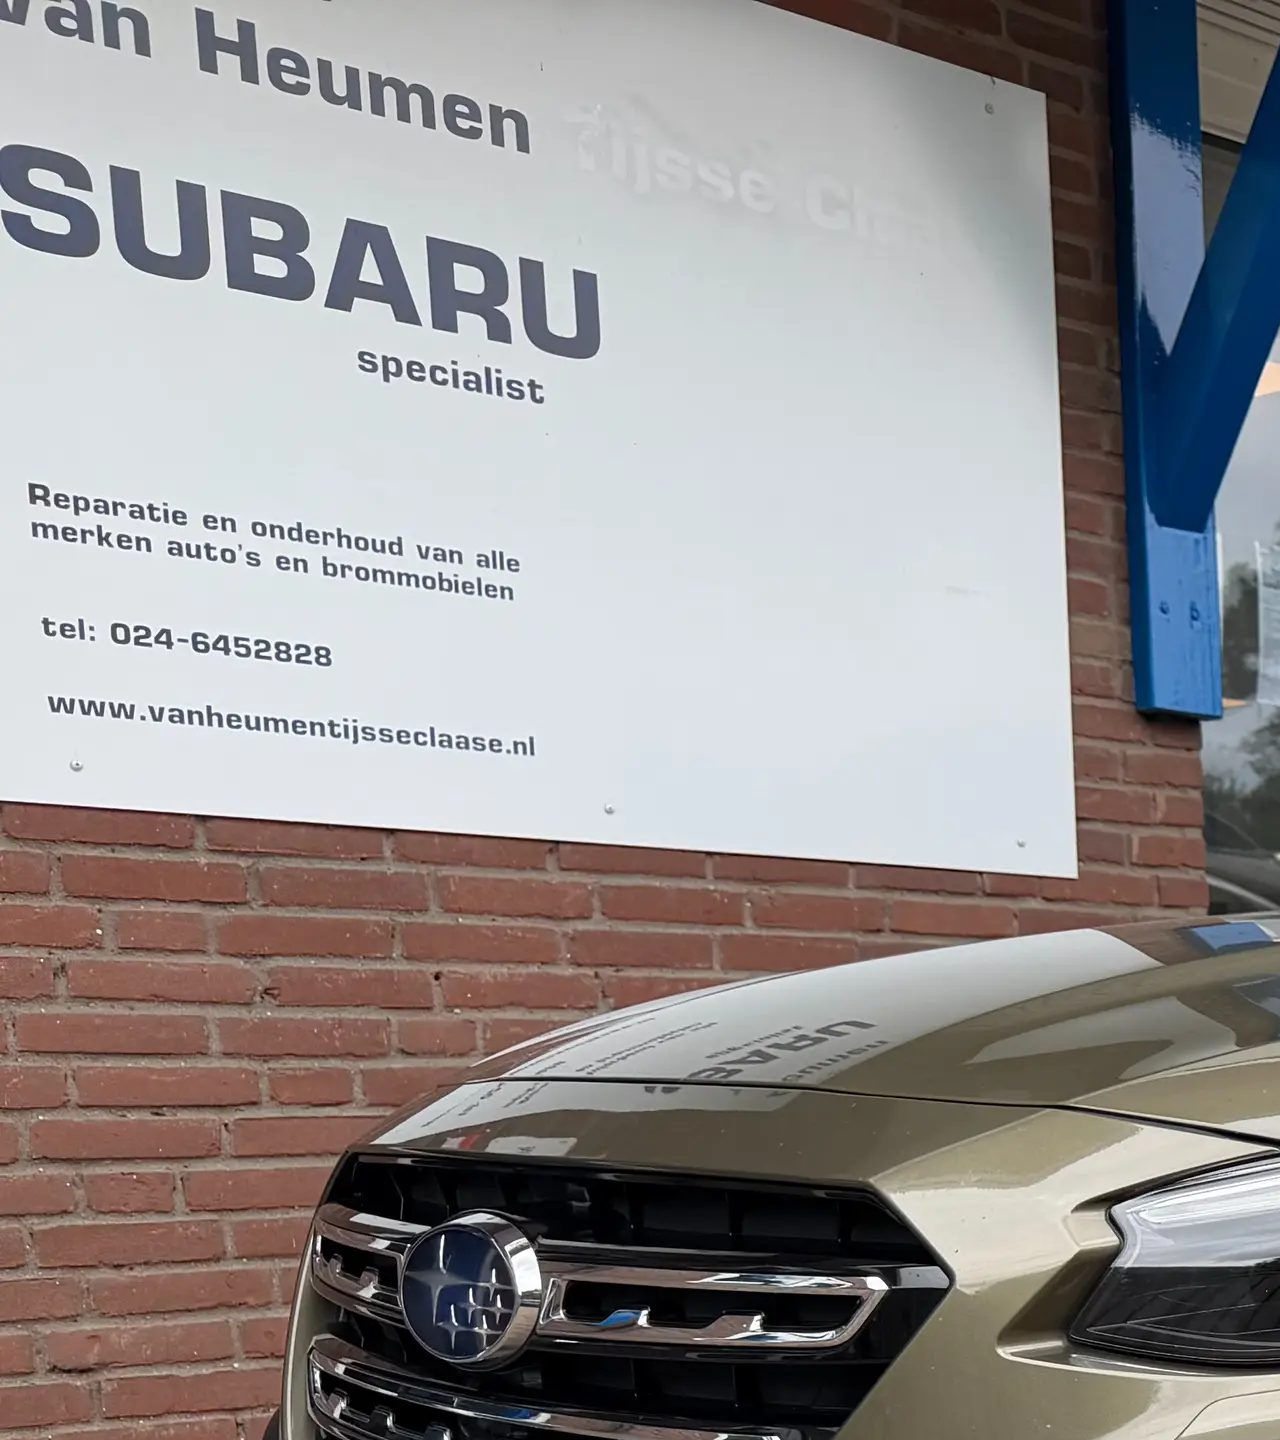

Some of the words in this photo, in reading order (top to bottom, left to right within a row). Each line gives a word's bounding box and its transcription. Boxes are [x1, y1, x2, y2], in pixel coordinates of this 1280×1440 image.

[195, 8, 530, 154] Heumen
[0, 144, 601, 360] SUBARU
[357, 350, 545, 404] specialist
[28, 483, 188, 526] Reparatie
[203, 514, 237, 533] en
[252, 521, 403, 557] onderhoud
[417, 544, 463, 565] van
[476, 551, 520, 573] alle
[32, 522, 152, 553] merken
[167, 541, 261, 567] auto's
[276, 556, 309, 574] en
[322, 556, 514, 601] brommobielen
[41, 618, 96, 642] tel:
[110, 622, 332, 667] 024-6452828
[47, 695, 535, 757] www.vanheumentijsseclaase.nl
